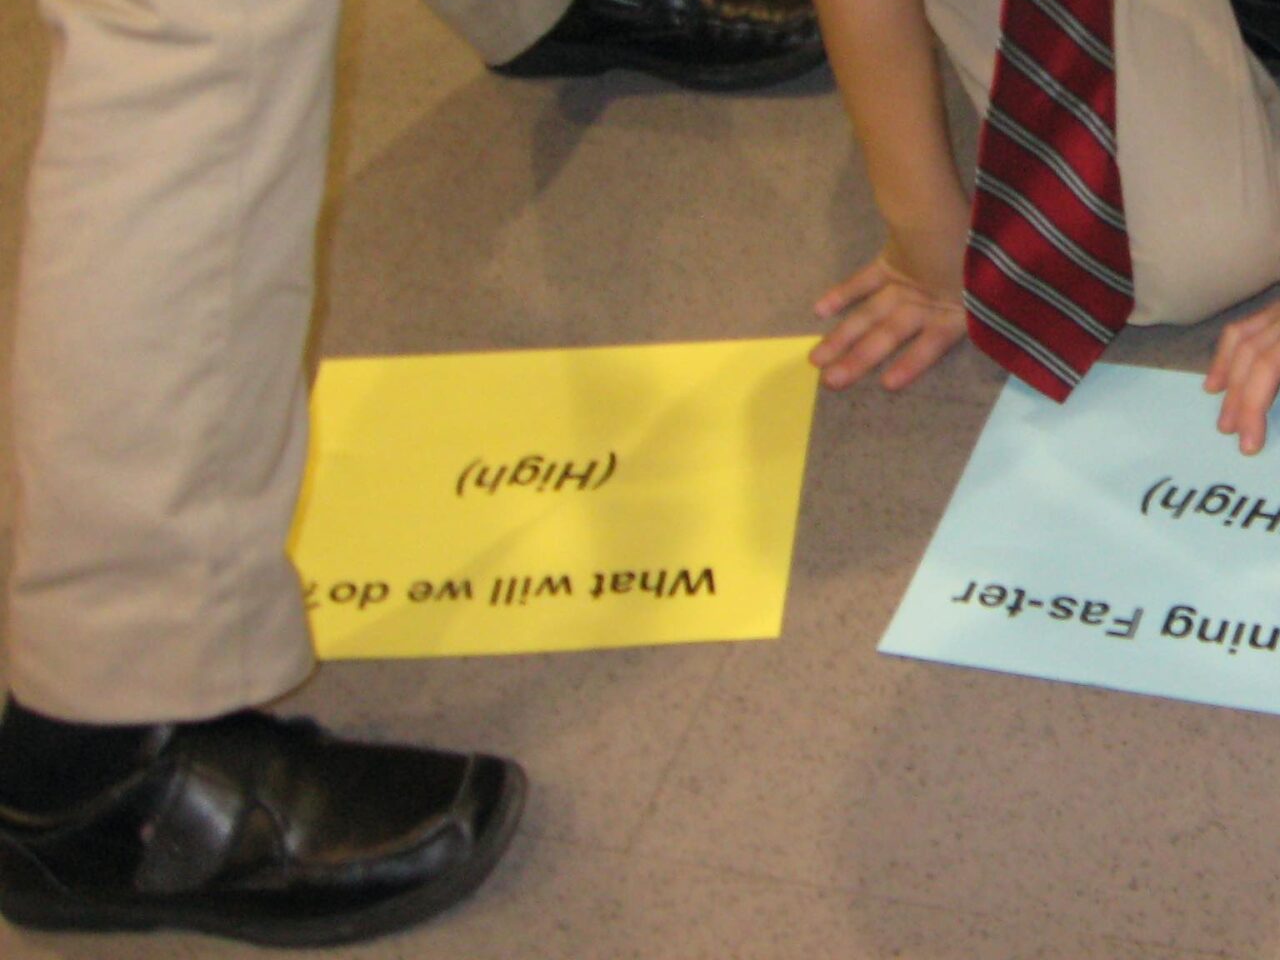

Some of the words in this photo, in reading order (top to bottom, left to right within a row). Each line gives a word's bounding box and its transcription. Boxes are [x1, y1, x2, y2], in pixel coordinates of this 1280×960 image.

[456, 451, 617, 497] (High)
[407, 579, 474, 603] we
[489, 574, 573, 606] will
[591, 567, 717, 600] What
[953, 579, 1145, 640] Fas-ter
